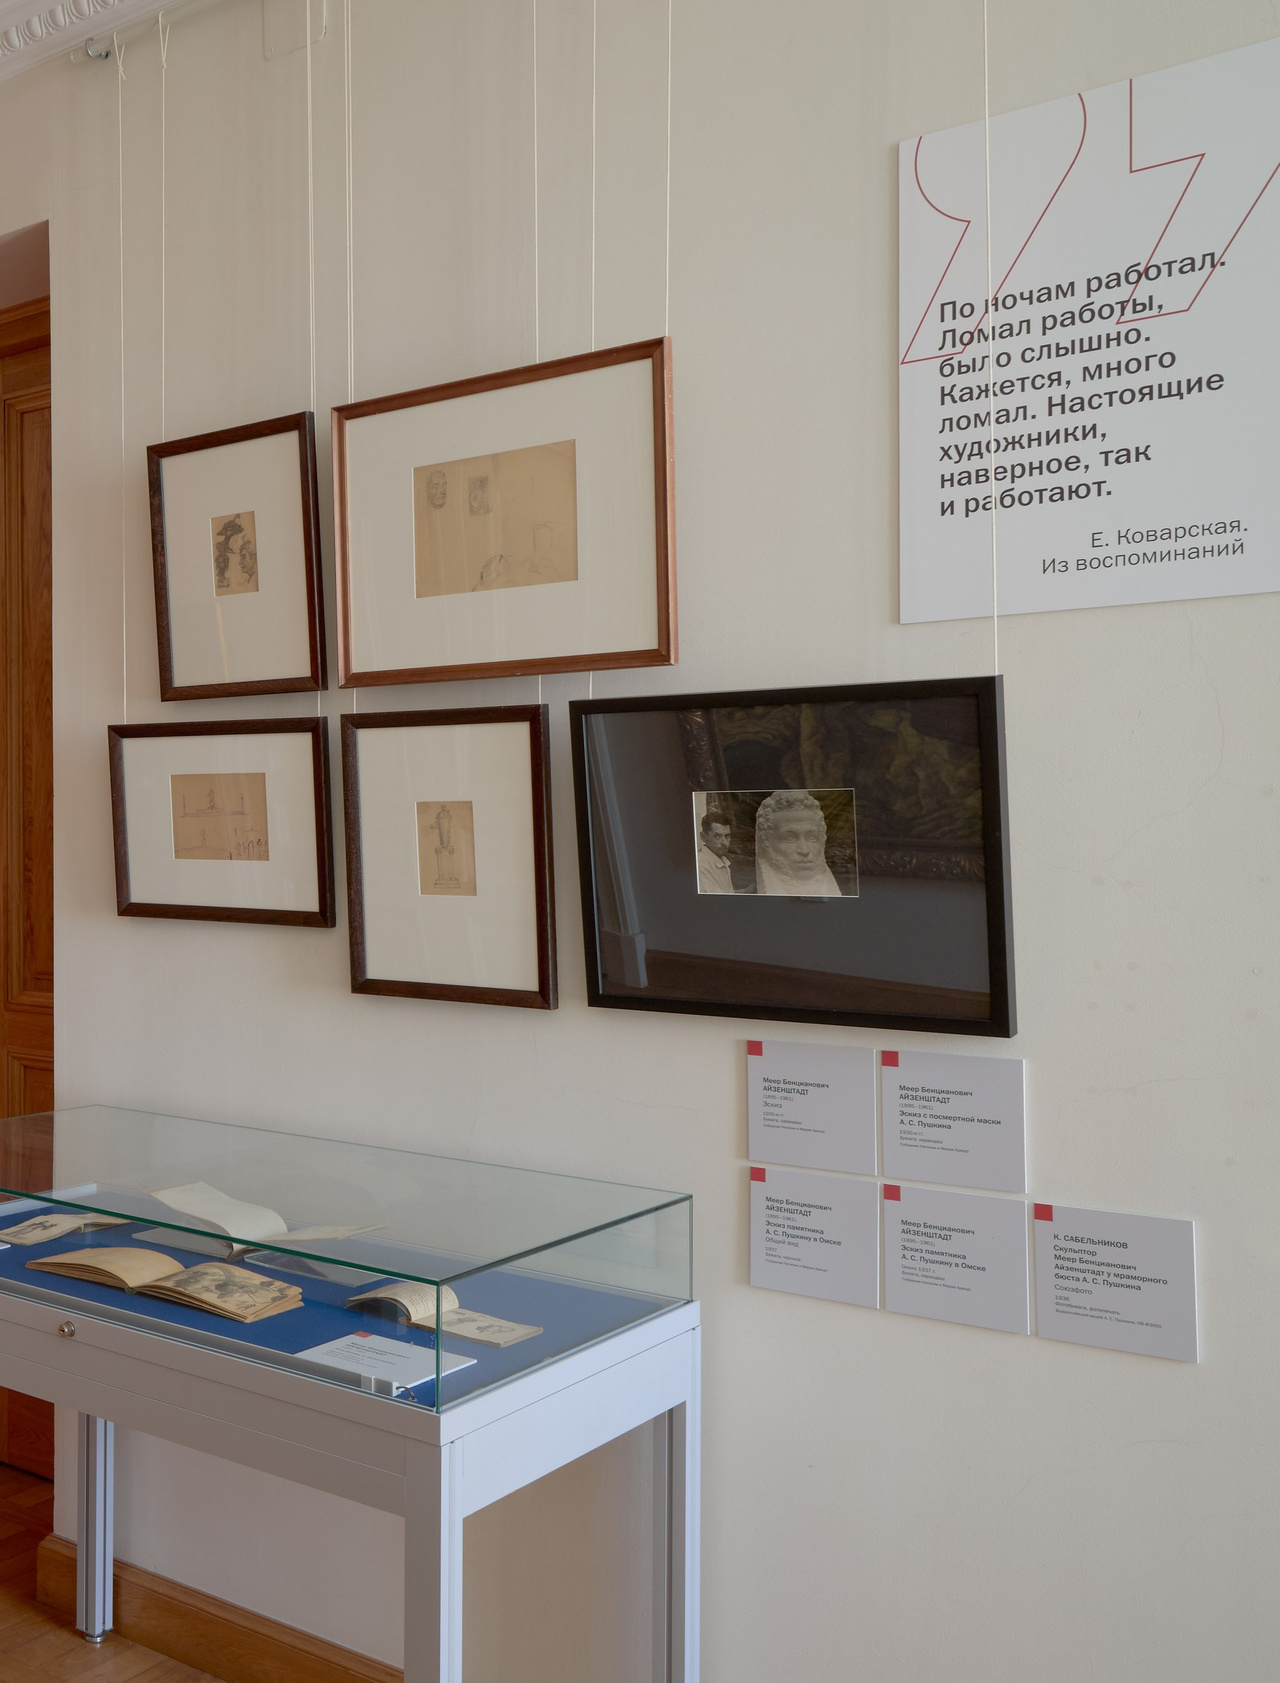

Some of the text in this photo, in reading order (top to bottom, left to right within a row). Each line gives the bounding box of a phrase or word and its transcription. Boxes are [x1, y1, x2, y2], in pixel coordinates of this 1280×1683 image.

[940, 252, 1225, 322] По ночам работал.
[938, 295, 1163, 351] Ломал работы,
[939, 328, 1150, 378] было слышно.
[940, 352, 1176, 406] Кажется, много
[938, 373, 1224, 434] ломал. Настоящие
[939, 423, 1107, 464] художники,
[940, 444, 1152, 488] наверное, так
[940, 479, 1112, 518] и работают.
[1092, 520, 1248, 548] Е. Коварская.
[1042, 538, 1244, 574] Из воспоминаний
[763, 1085, 809, 1096] АЙЗЕНШТАДТ
[783, 1079, 829, 1088] Бенцианович
[899, 1085, 972, 1096] Меер Бенцианович
[899, 1093, 950, 1104] АЙЗЕНШТАДТ
[899, 1110, 921, 1118] Эскиз
[929, 1114, 974, 1122] посмертной
[976, 1118, 1001, 1126] маски
[918, 1120, 952, 1130] Пушкина
[766, 1196, 832, 1212] Меер Бенцианович
[766, 1204, 812, 1217] АЙЗЕНШТАДТ
[766, 1220, 824, 1234] Эскиз памятника
[901, 1220, 974, 1235] Меер Бенцианович
[901, 1228, 952, 1241] АЙЗЕНШТАДТ
[782, 1231, 812, 1242] Пушкину
[819, 1237, 842, 1246] Омске
[1064, 1235, 1128, 1250] САБЕЛЬНИКОВ
[901, 1245, 966, 1260] Эскиз памятника
[1054, 1244, 1097, 1256] Скульптор
[920, 1256, 953, 1268] Пушкину
[961, 1262, 986, 1272] Омске
[1054, 1254, 1136, 1270] Меер Бенцианович
[1054, 1264, 1104, 1276] Айзенштадт
[1114, 1273, 1168, 1285] мраморного
[1054, 1272, 1080, 1282] бюста
[1082, 1276, 1090, 1284] А.
[1102, 1280, 1142, 1290] Пушкина
[1054, 1284, 1092, 1295] Союзфото
